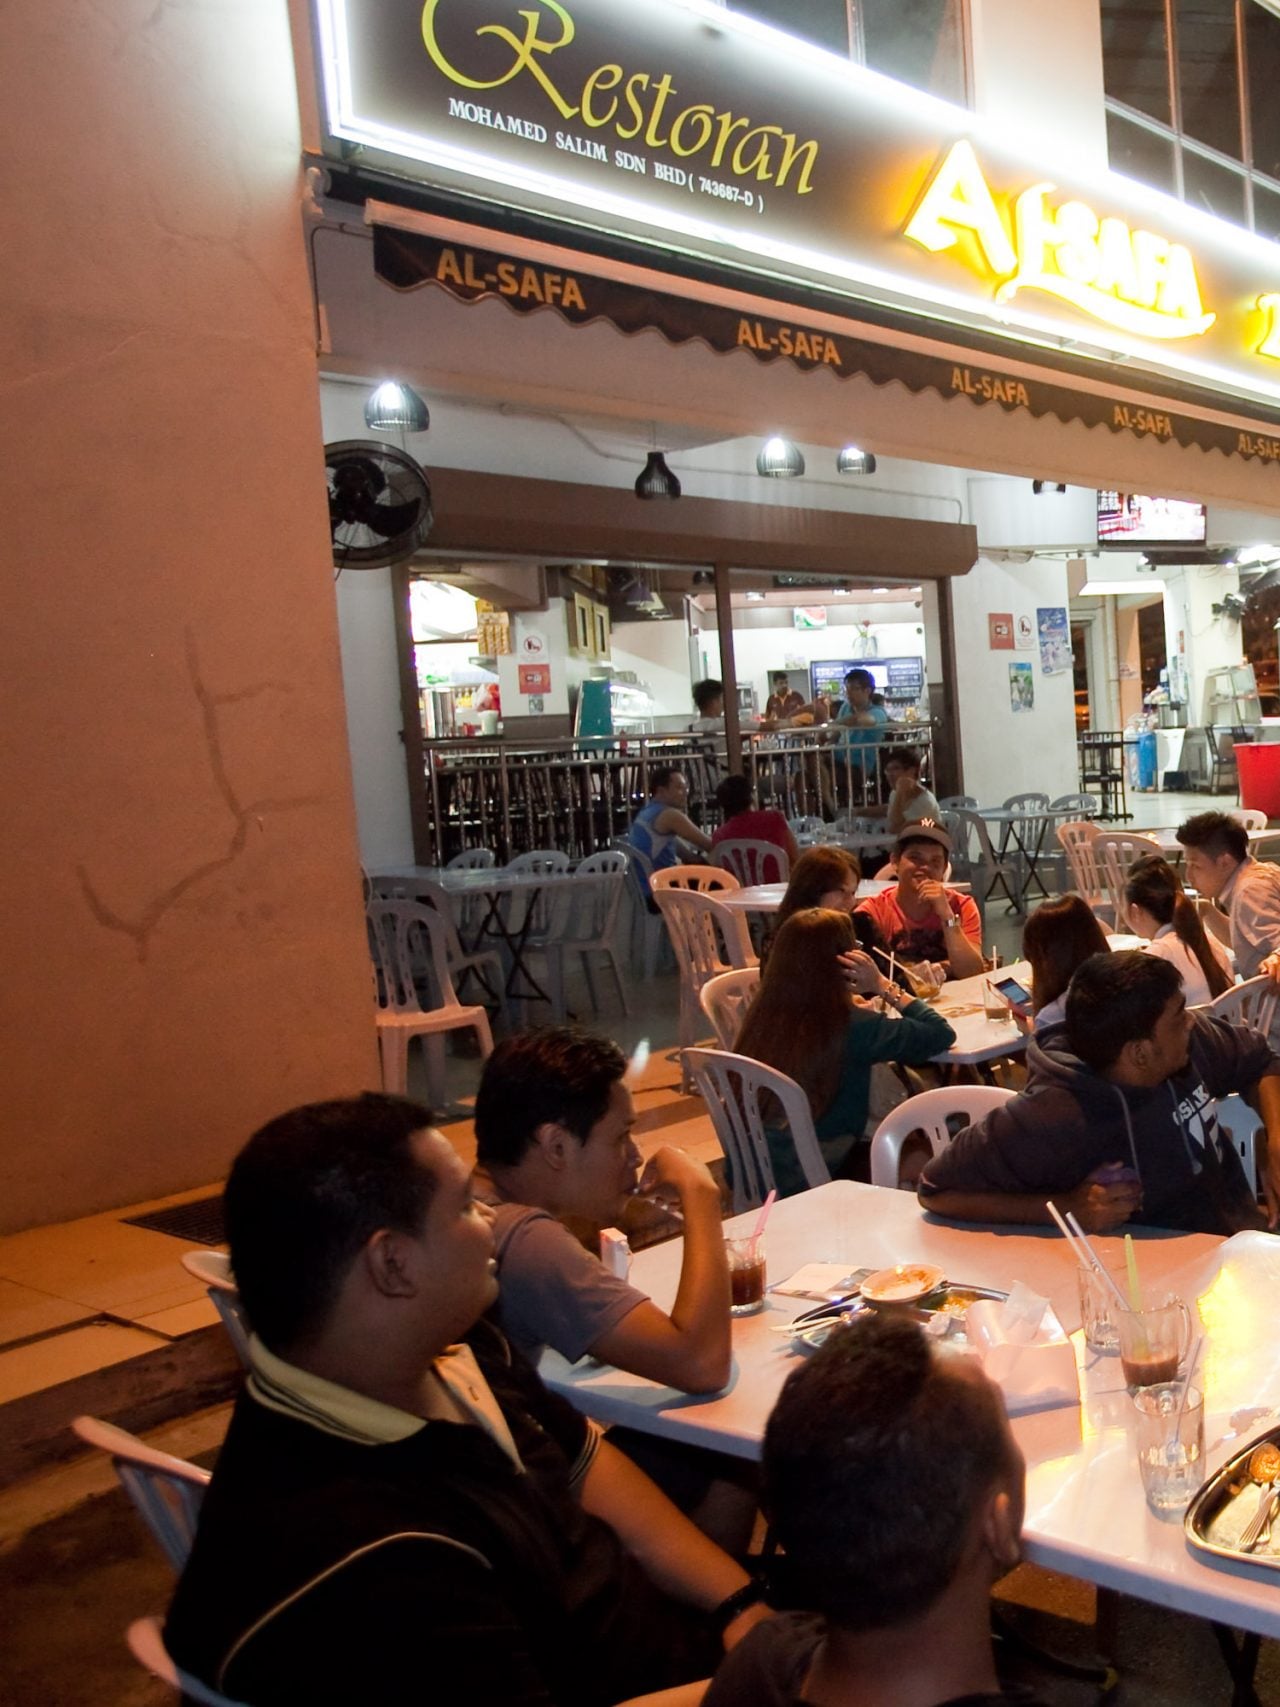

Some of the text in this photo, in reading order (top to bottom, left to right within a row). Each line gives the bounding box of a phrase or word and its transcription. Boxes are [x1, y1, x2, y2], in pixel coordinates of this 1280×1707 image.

[421, 0, 819, 194] Restoran
[448, 97, 548, 144] MOHAMED
[555, 131, 609, 163] SALIM
[615, 149, 647, 175] SDN
[436, 248, 587, 311] AL-SAFA
[737, 318, 842, 366] AL-SAFA
[951, 366, 1030, 407] AL-SAFA
[1113, 405, 1174, 437] AL-SAFA
